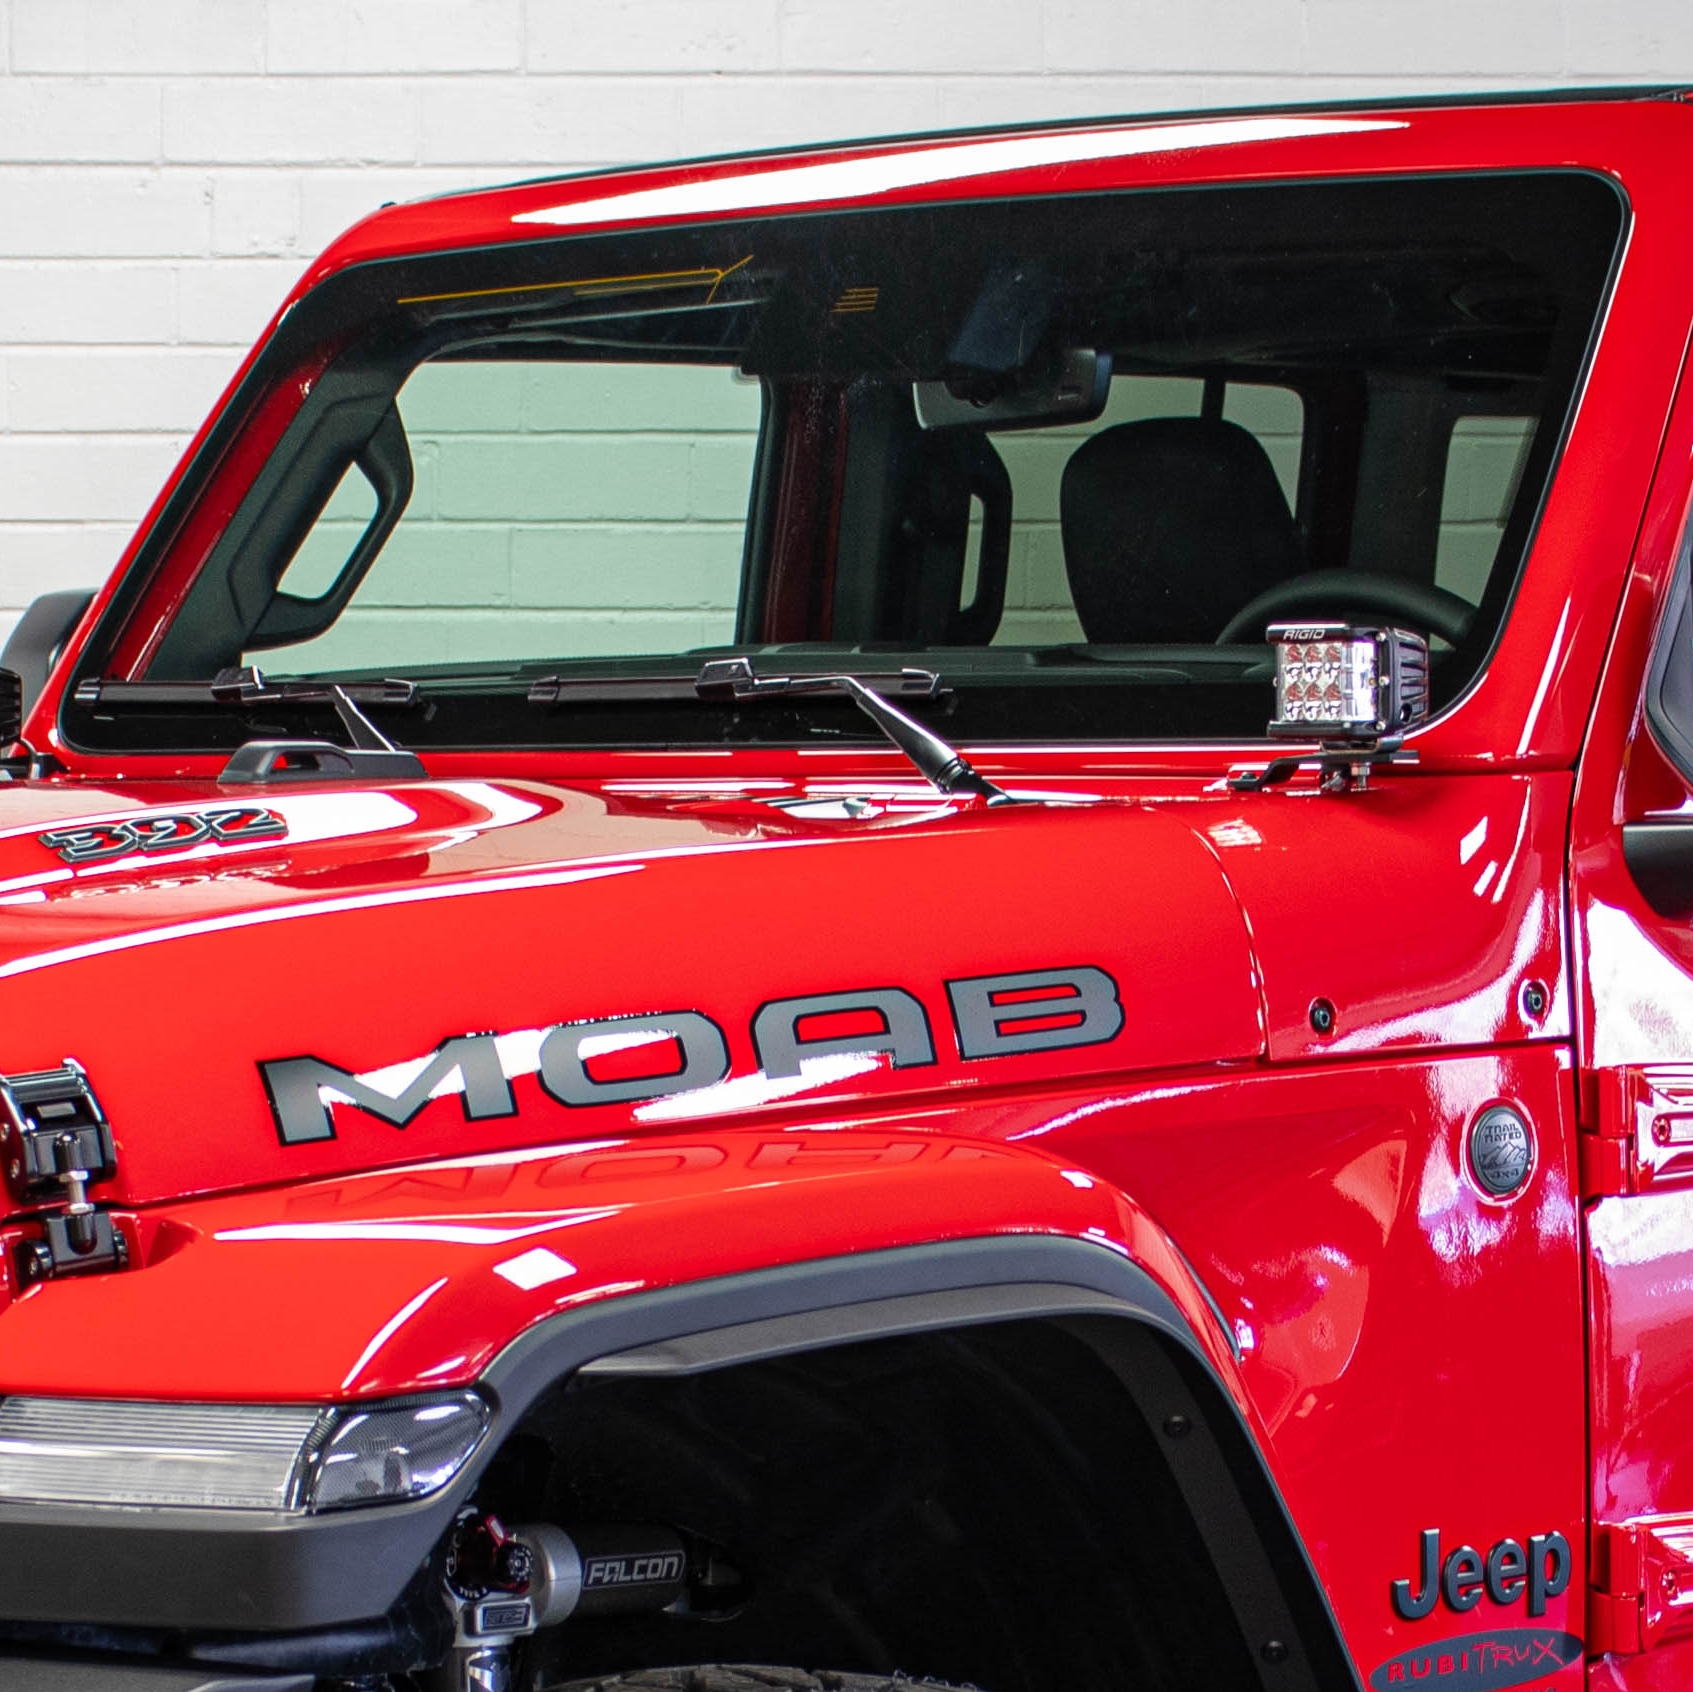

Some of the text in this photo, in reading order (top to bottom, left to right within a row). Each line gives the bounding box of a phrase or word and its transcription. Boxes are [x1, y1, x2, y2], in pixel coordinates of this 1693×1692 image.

[1283, 629, 1326, 640] RIGID
[38, 808, 289, 864] 392
[257, 964, 1126, 1148] MOAB
[1483, 1131, 1522, 1143] RATED
[1485, 1123, 1519, 1135] TRAIL
[587, 1556, 679, 1586] FALCON
[1390, 1527, 1573, 1622] Jeep
